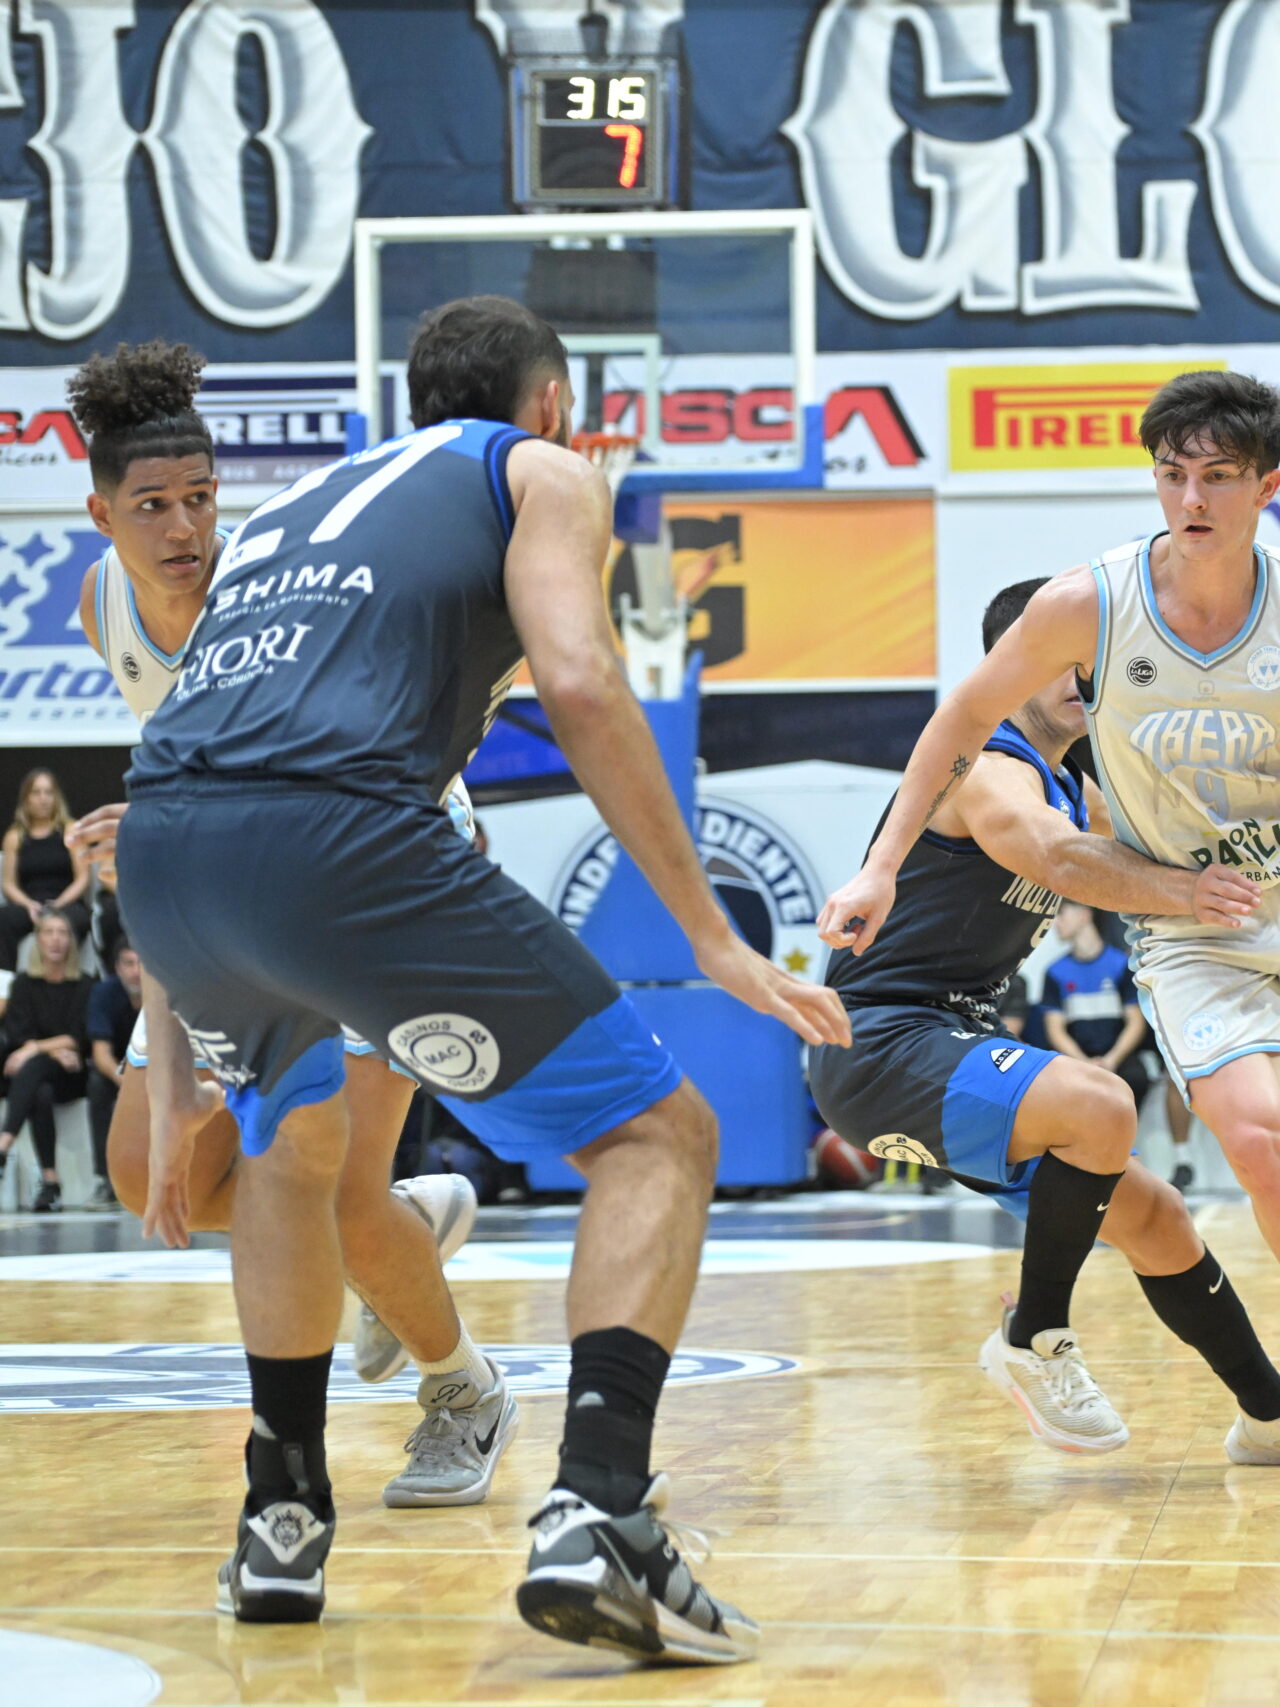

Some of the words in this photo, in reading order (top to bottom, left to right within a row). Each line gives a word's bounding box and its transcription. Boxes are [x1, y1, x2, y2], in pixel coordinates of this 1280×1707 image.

[0, 0, 375, 341] JO
[604, 124, 643, 189] 7
[424, 1044, 462, 1065] MAC
